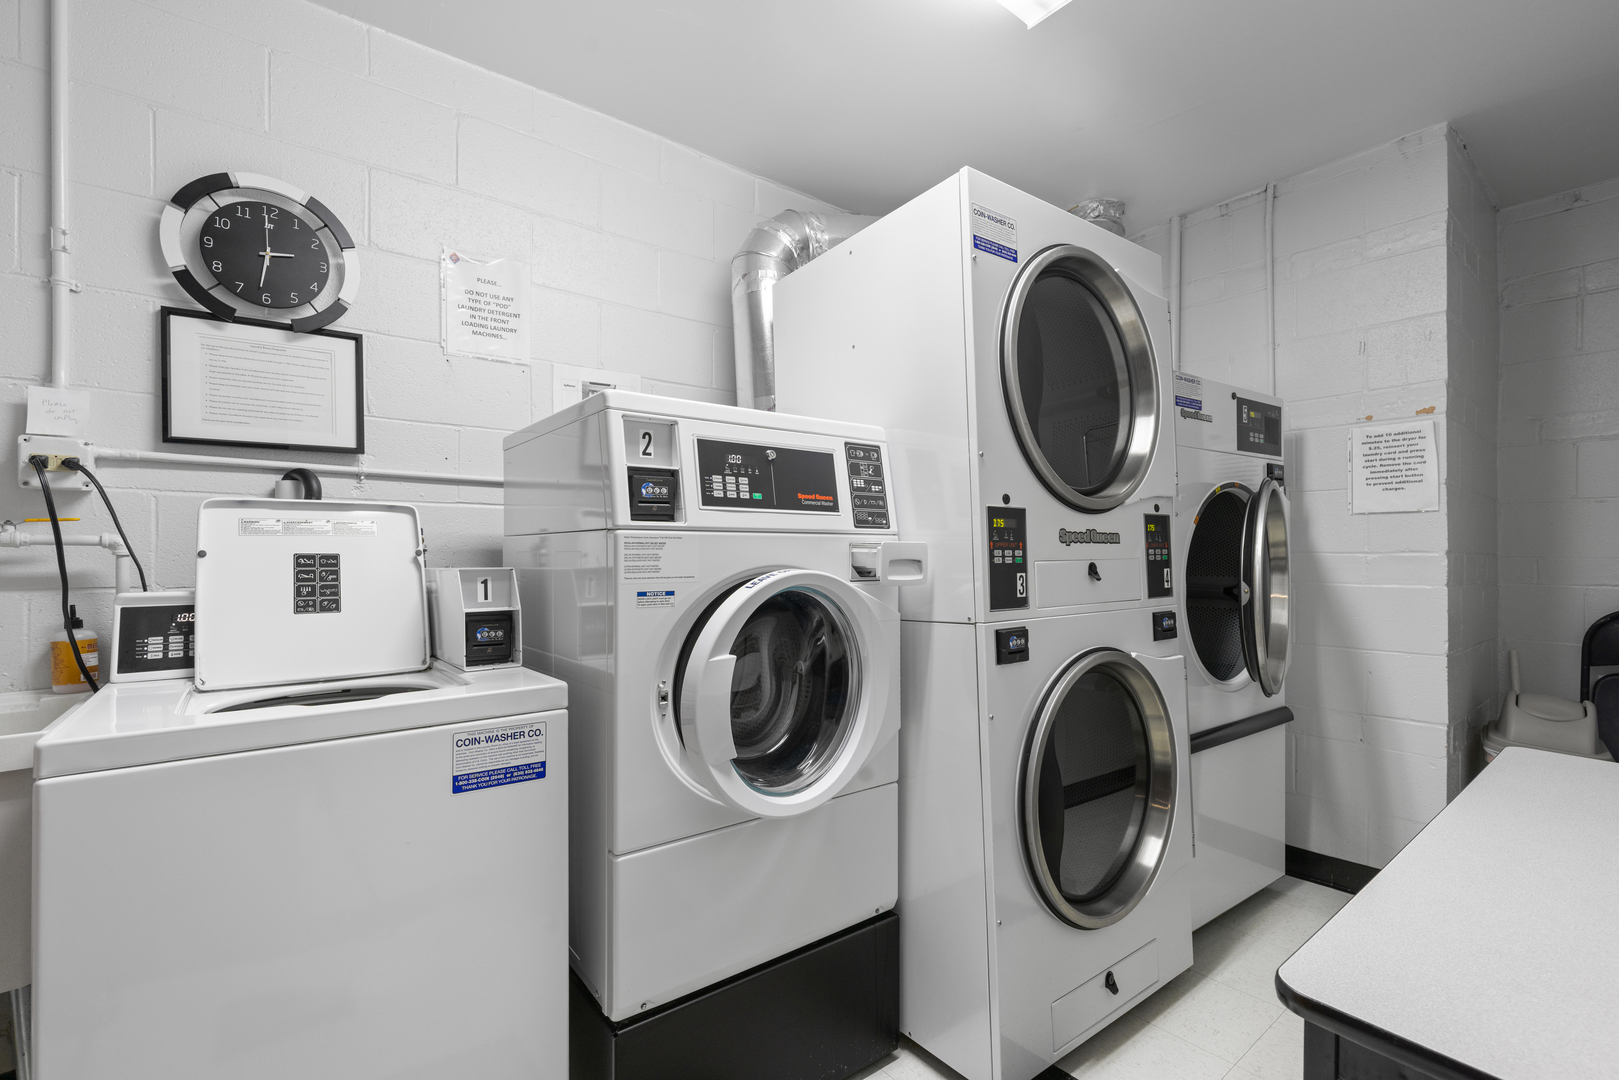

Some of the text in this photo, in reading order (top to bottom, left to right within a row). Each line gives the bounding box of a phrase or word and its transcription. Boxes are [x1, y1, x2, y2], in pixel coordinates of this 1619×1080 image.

[236, 206, 251, 219] 11
[261, 206, 278, 219] 12
[974, 208, 1006, 226] COIN-WASHER
[214, 217, 230, 230] 10
[293, 219, 300, 230] 1
[204, 236, 213, 248] 9
[311, 239, 319, 249] 2
[212, 261, 222, 272] 8
[320, 262, 328, 273] 3
[235, 282, 244, 292] 7
[310, 283, 318, 292] 4
[262, 294, 271, 304] 6
[290, 293, 299, 303] 5
[458, 304, 521, 318] LAUNDRY DETERGENT
[461, 320, 518, 334] LOADING LAUNDRY
[642, 431, 652, 456] 2
[1166, 570, 1169, 586] 4
[481, 579, 488, 600] 1
[1018, 574, 1025, 596] 3
[456, 728, 544, 748] COIN-WASHER CO.
[511, 774, 537, 782] PATRONAGE.
